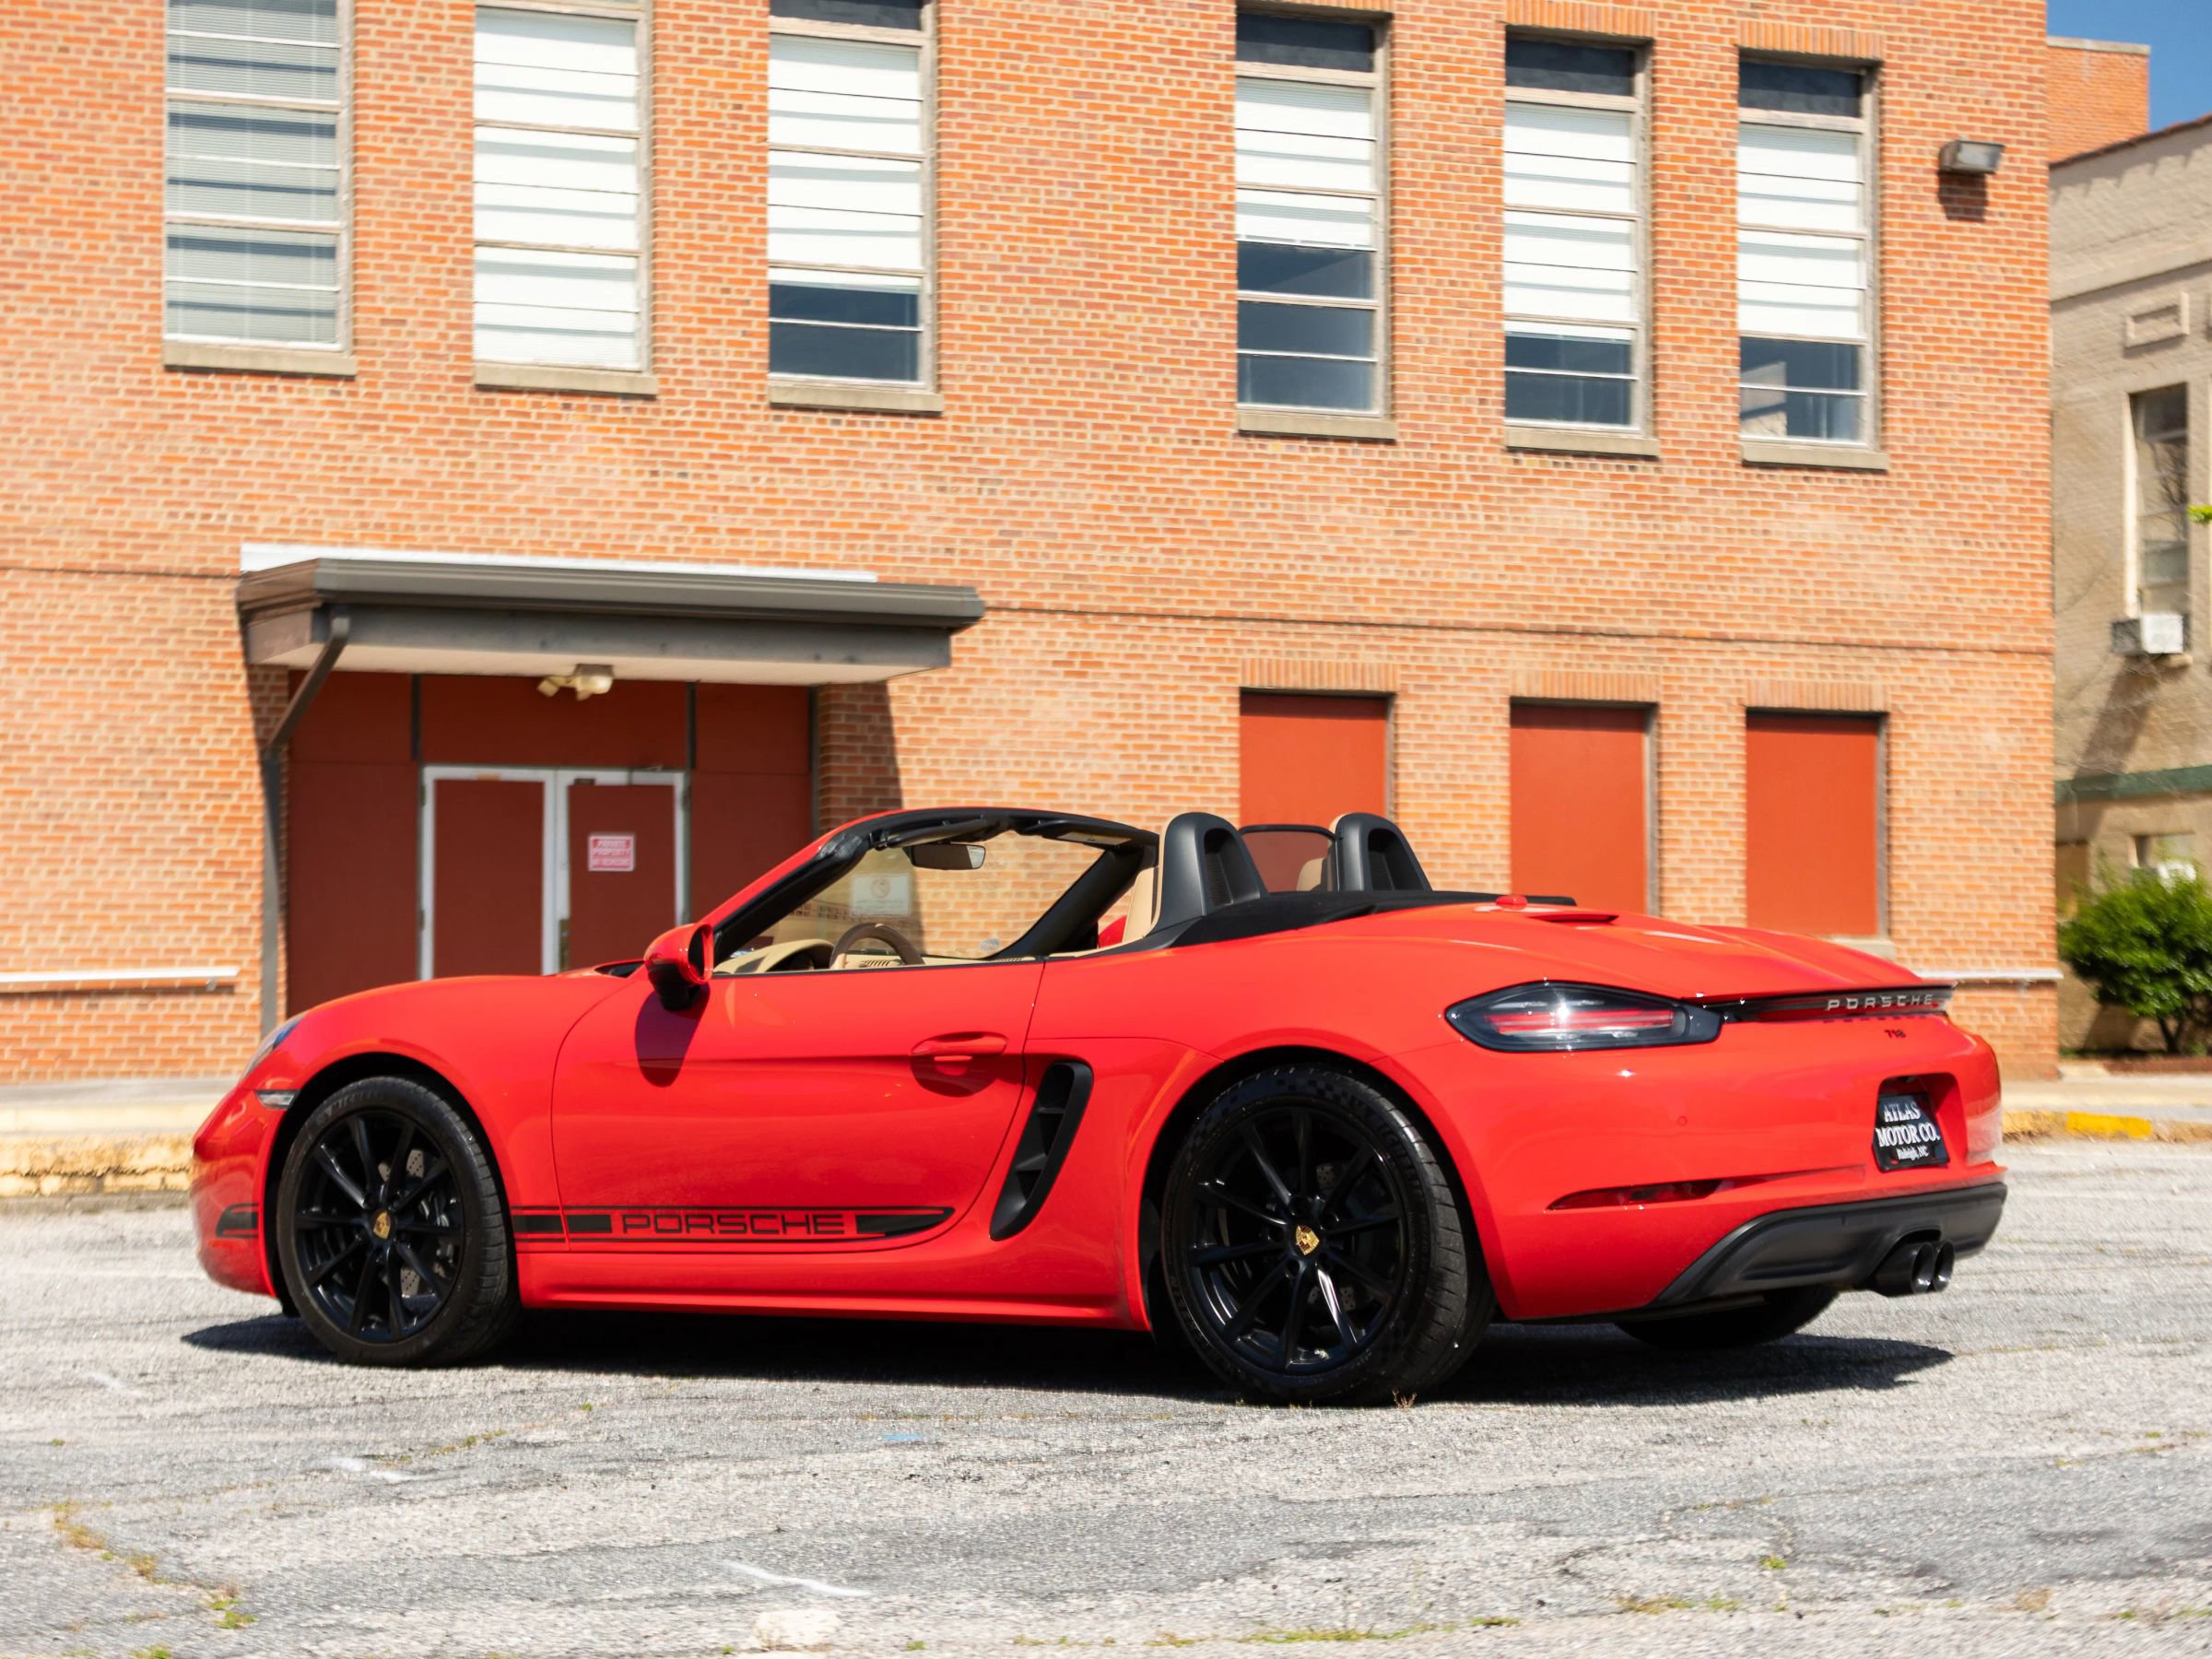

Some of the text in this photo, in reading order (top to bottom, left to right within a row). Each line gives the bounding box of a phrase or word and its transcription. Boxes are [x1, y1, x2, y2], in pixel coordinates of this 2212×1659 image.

[1826, 994, 1933, 1010] PORSCHE
[1884, 1029, 1906, 1038] 718
[1884, 1101, 1921, 1122] ATLAS
[1875, 1122, 1941, 1147] MOTOR CO.
[621, 1213, 846, 1235] PORSCHE
